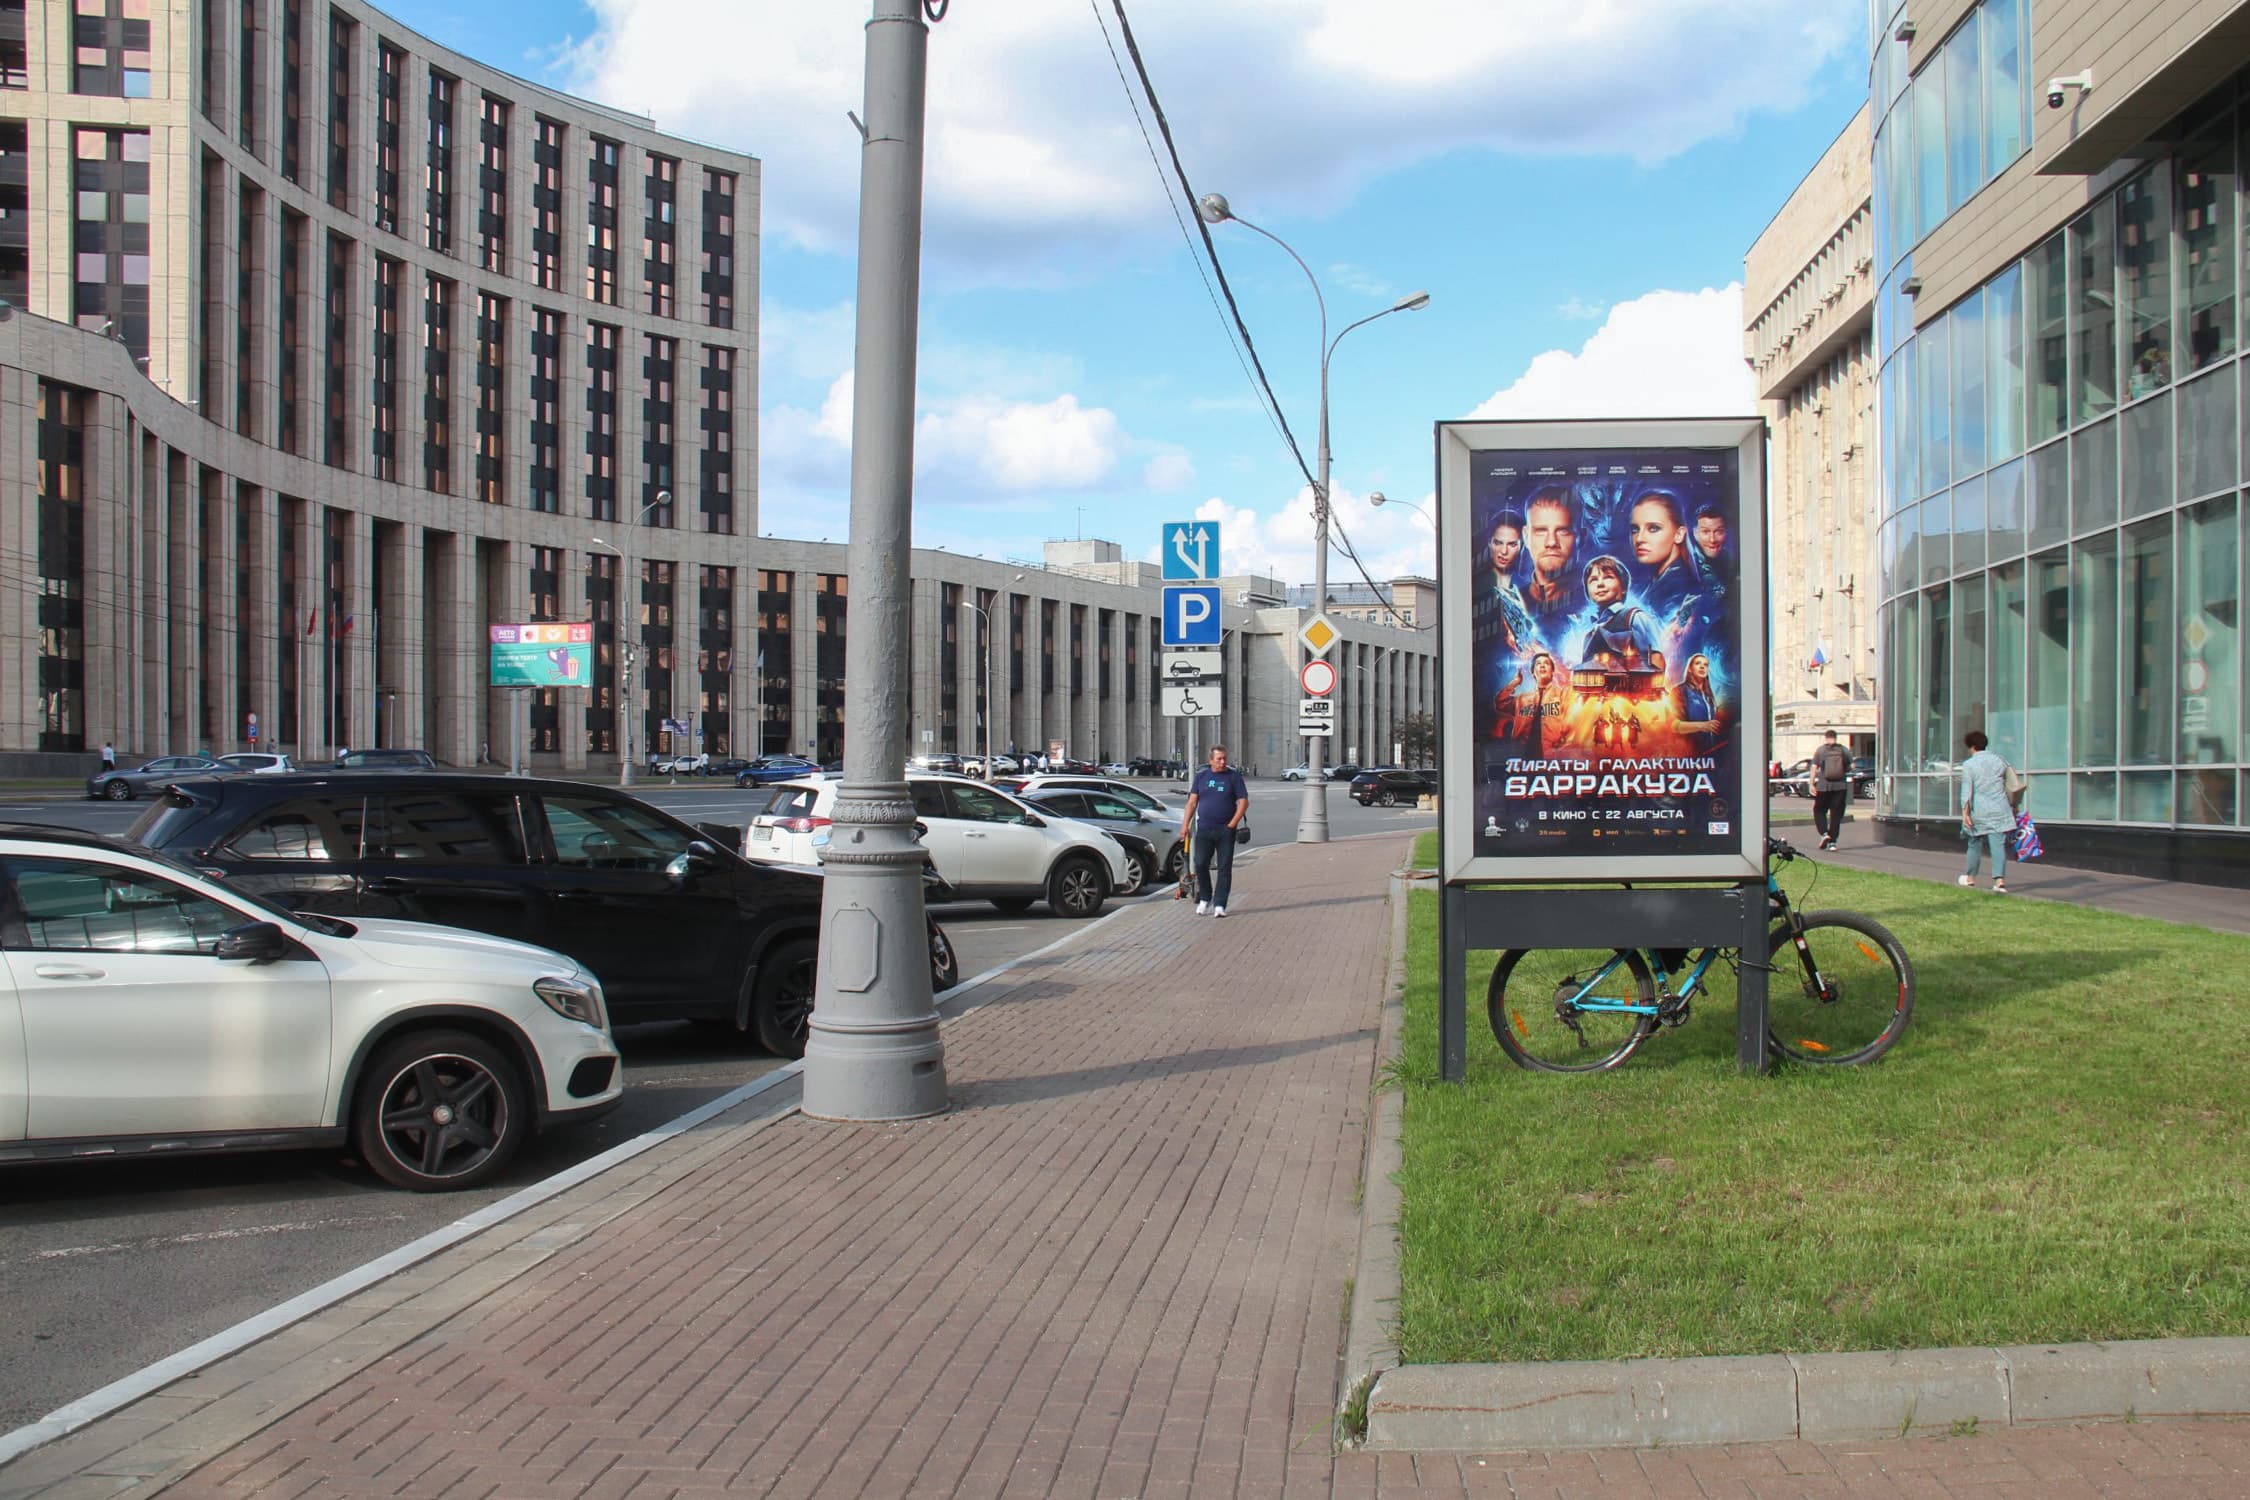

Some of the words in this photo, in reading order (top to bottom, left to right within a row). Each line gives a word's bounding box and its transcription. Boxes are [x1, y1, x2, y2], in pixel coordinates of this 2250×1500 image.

[1179, 594, 1210, 639] P
[1505, 758, 1590, 773] ПИРАТЫ
[1599, 757, 1716, 771] ГАЛАКТИКИ
[1504, 773, 1717, 798] БАРРАКУДА
[1538, 810, 1548, 820] В
[1552, 810, 1587, 820] КИНО
[1591, 810, 1601, 820] С
[1605, 810, 1621, 819] 22
[1626, 809, 1685, 819] АВГУСТА
